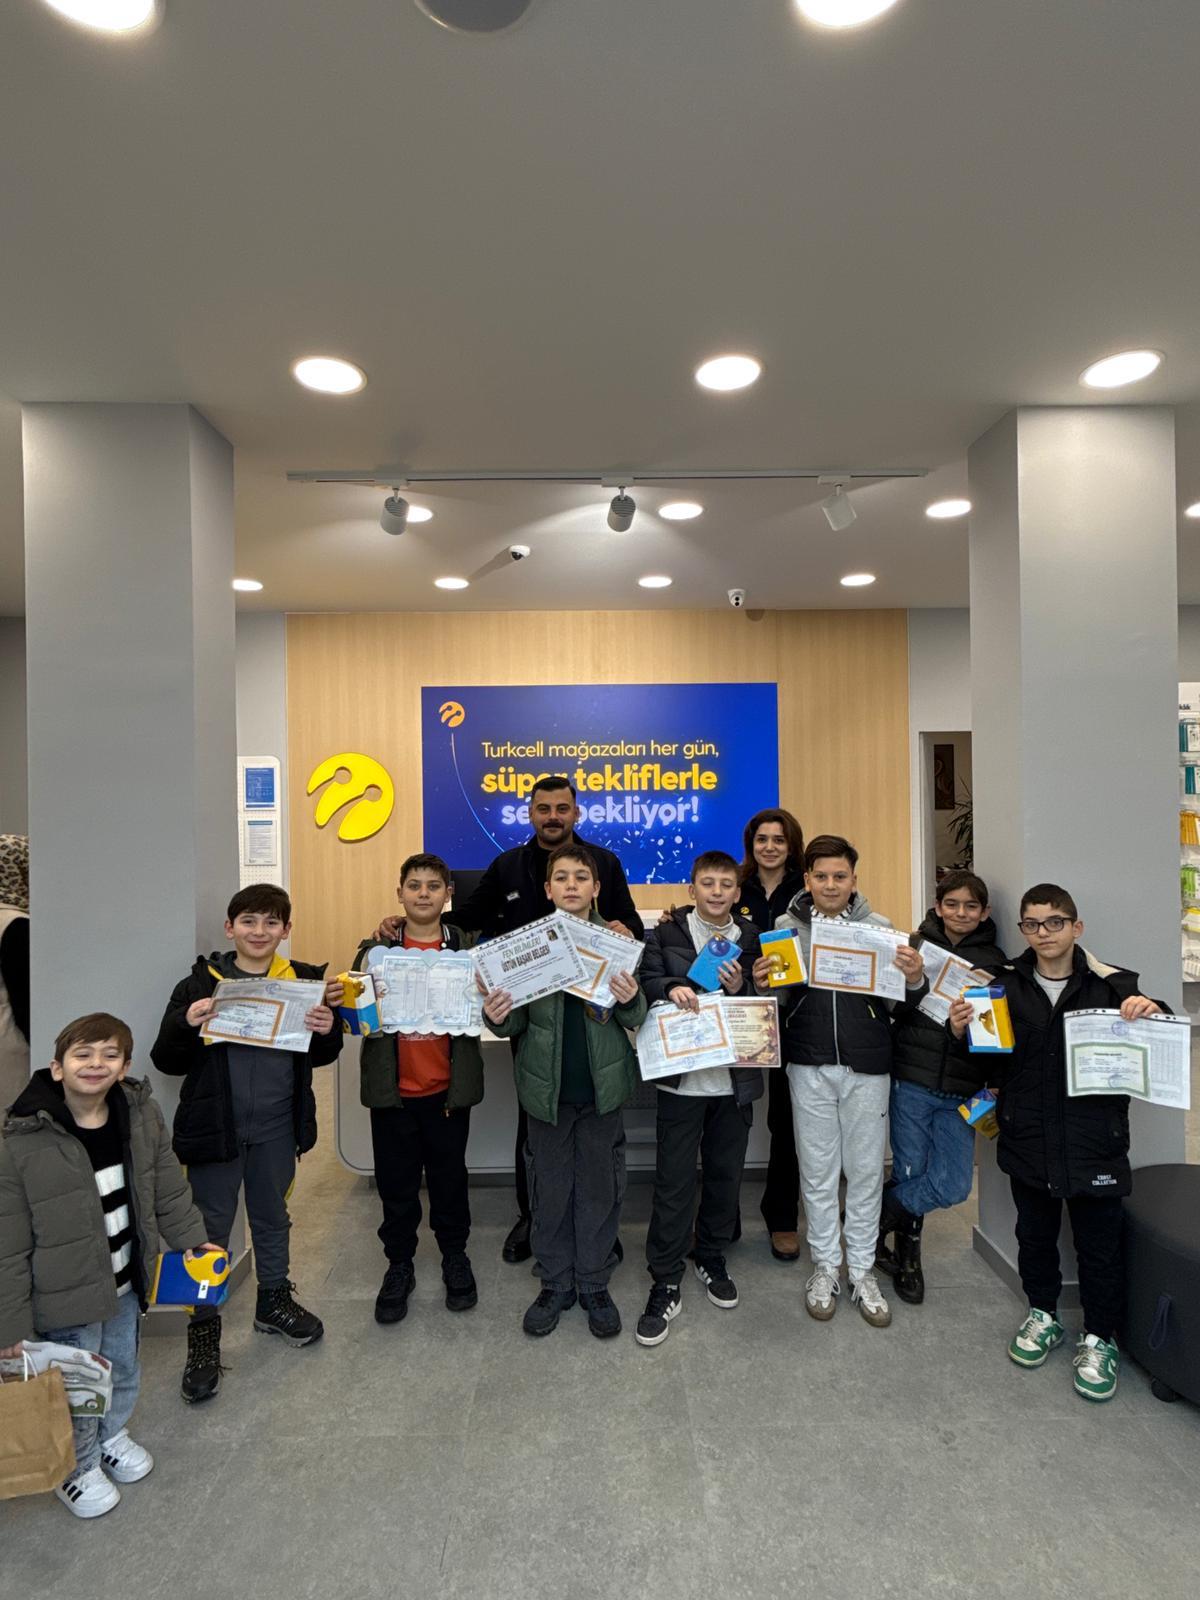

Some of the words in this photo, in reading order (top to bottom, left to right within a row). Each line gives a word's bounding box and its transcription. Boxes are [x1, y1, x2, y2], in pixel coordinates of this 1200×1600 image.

[481, 741, 544, 758] Turkcell
[548, 739, 646, 761] mağazaları
[650, 739, 679, 756] her
[683, 739, 719, 760] gün,
[482, 766, 568, 799] süp
[574, 763, 718, 791] tekliflerle
